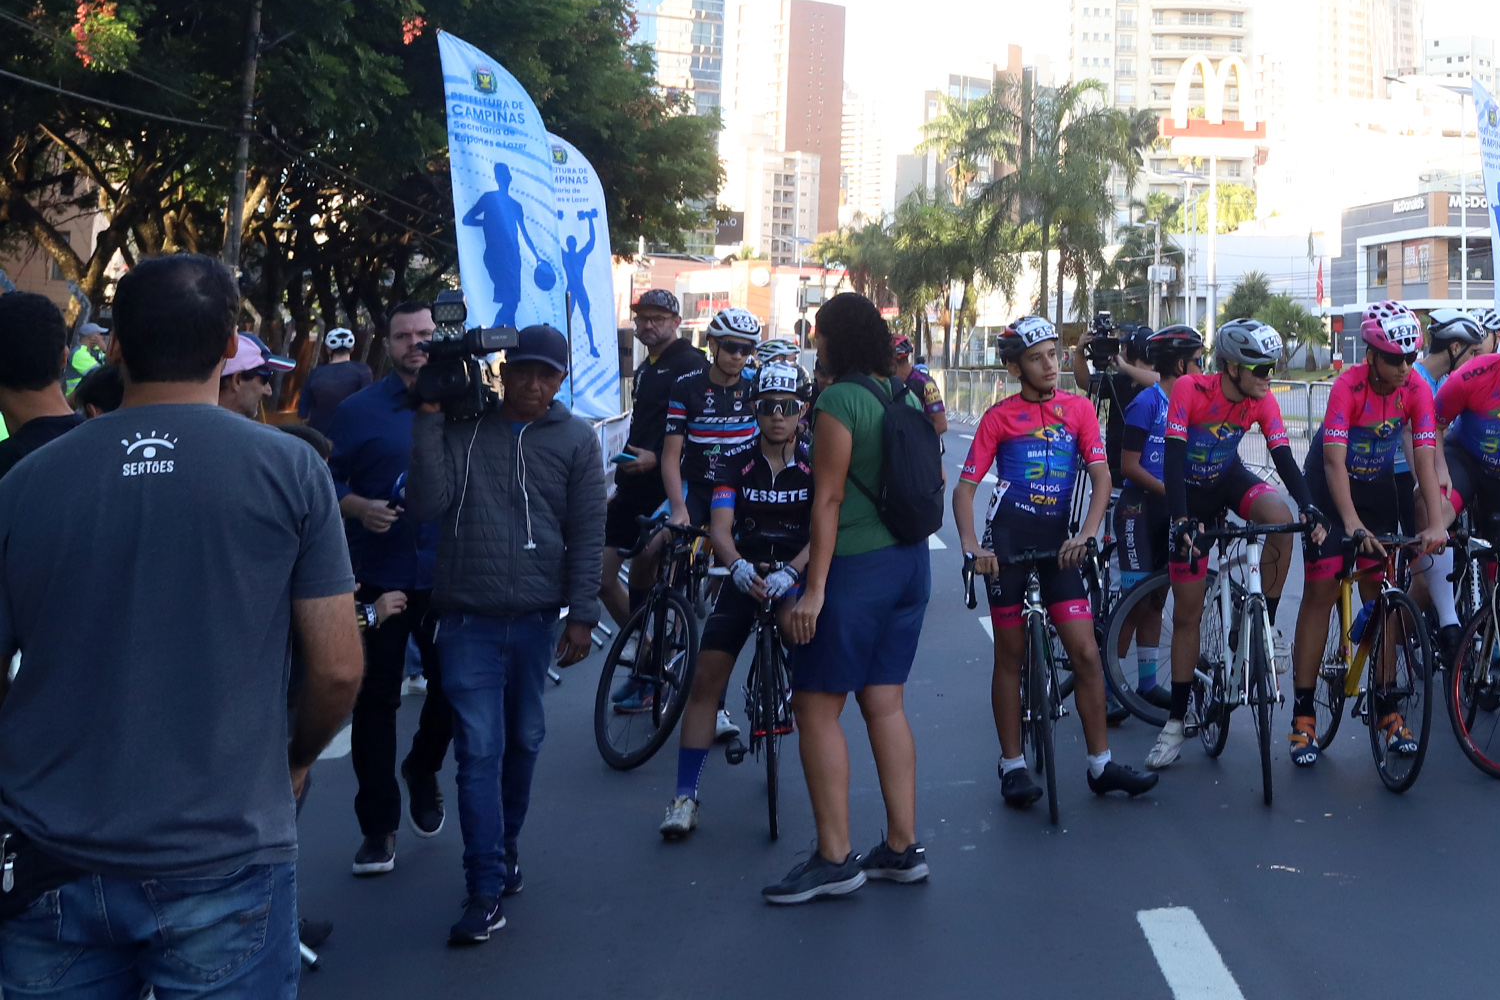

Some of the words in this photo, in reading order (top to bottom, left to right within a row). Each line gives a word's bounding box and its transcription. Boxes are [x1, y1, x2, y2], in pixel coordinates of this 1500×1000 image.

[450, 92, 509, 109] PREFEITURA
[511, 100, 524, 110] DE
[451, 103, 526, 124] CAMPINAS
[453, 120, 500, 135] Secretaria
[503, 127, 516, 136] de
[454, 133, 494, 147] Esportes
[503, 140, 527, 150] Lazer
[1392, 325, 1415, 338] 237
[765, 378, 790, 388] 231
[693, 415, 754, 424] FIRST
[724, 440, 758, 457] VESSET
[122, 460, 175, 476] SERTÕES
[742, 486, 808, 503] VESSETE
[1124, 533, 1135, 549] PRO
[1127, 547, 1141, 570] TEAM
